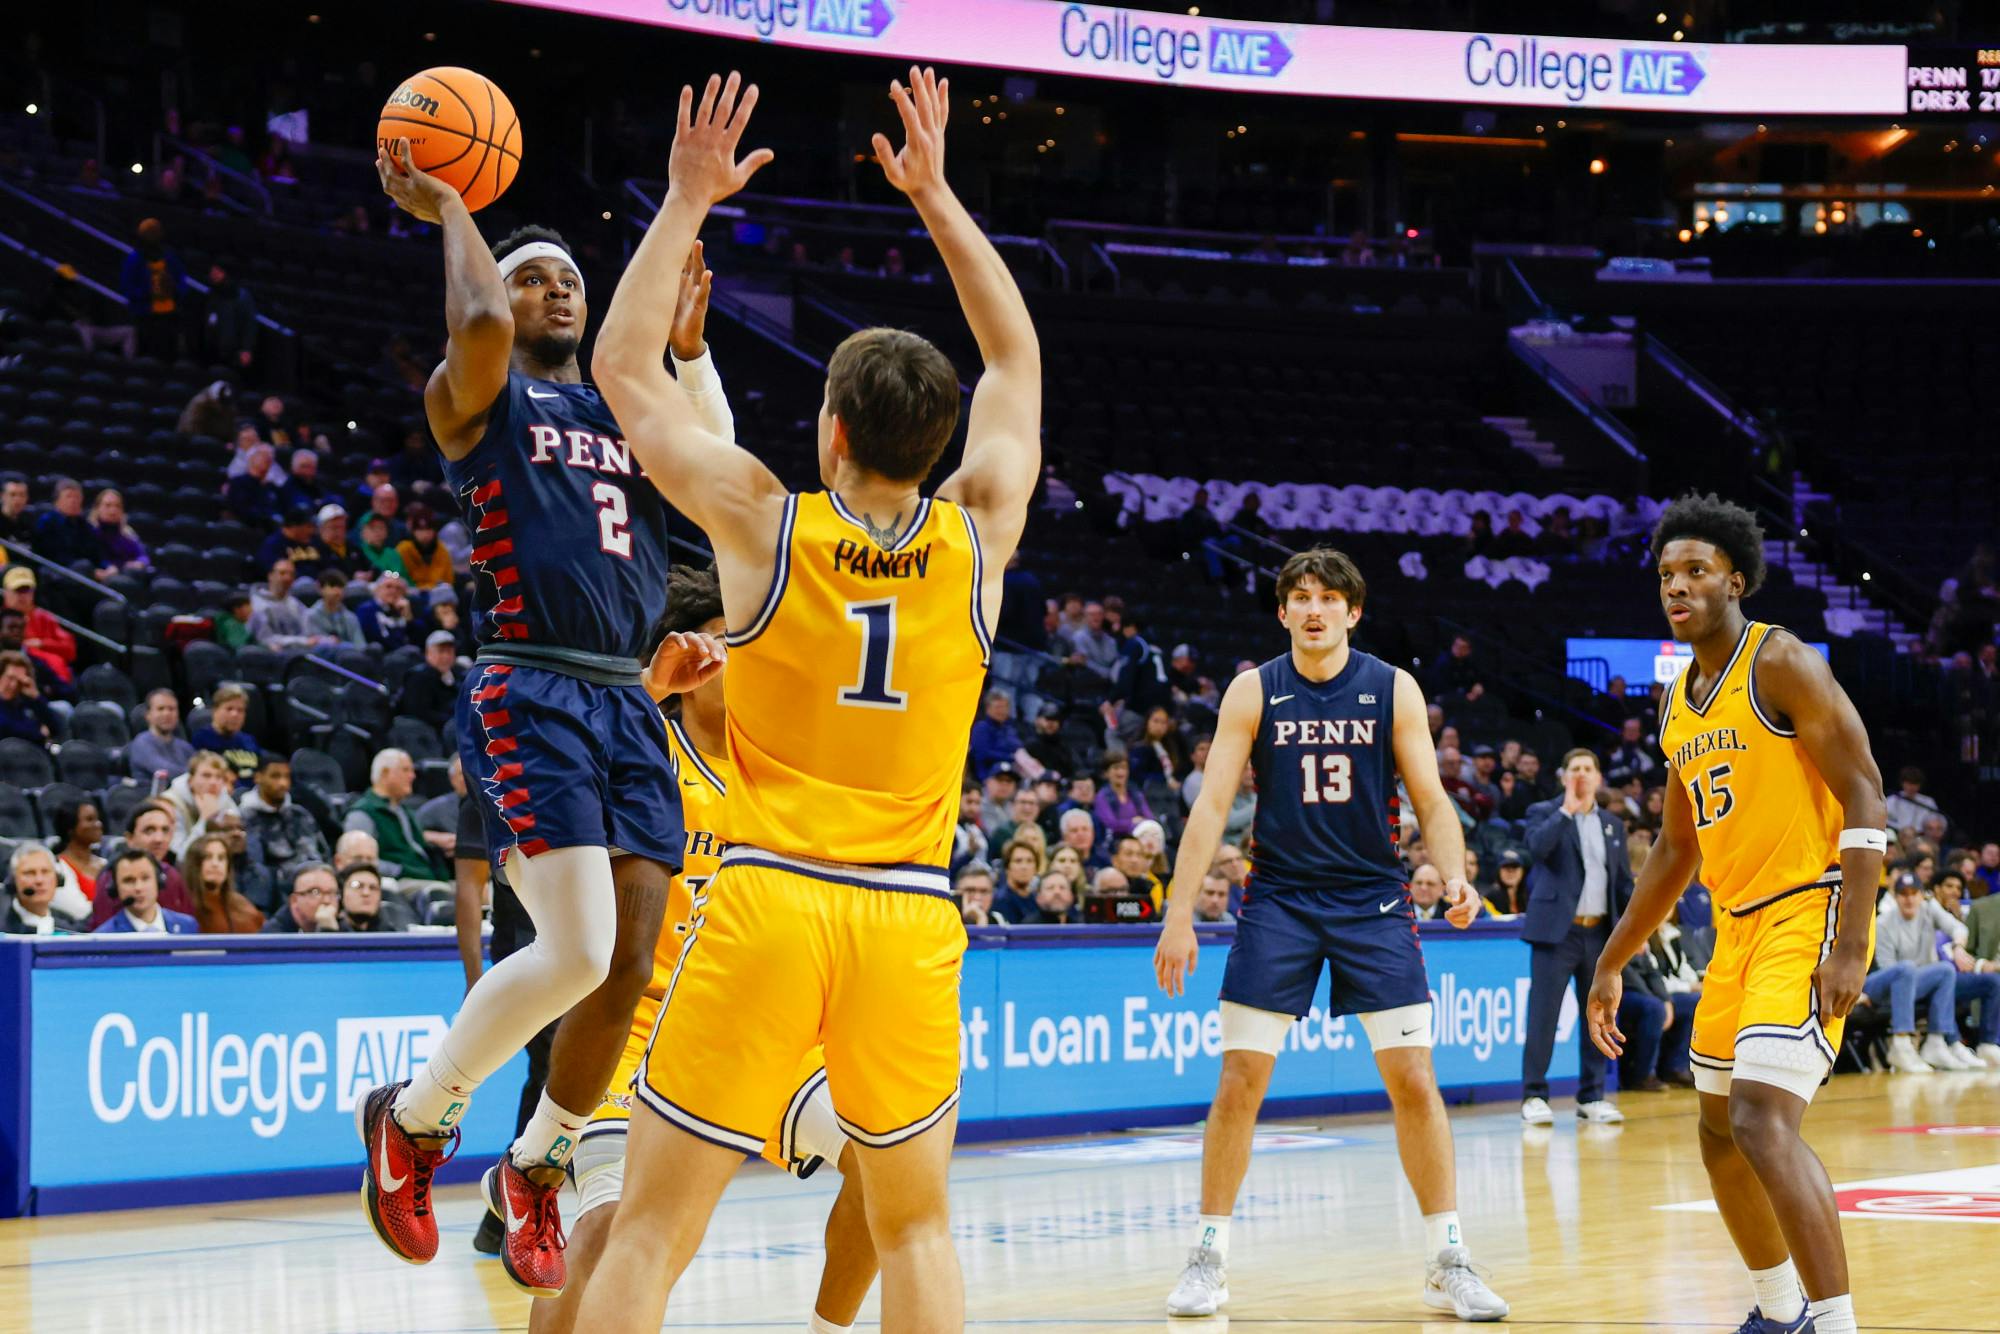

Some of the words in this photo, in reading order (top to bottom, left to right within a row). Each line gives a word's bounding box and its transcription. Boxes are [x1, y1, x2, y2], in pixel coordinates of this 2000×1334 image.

[1061, 6, 1201, 78] College
[1212, 32, 1272, 73] AVE
[1466, 35, 1612, 101] College
[1625, 53, 1686, 92] AVE
[389, 85, 440, 117] lson
[1908, 67, 1966, 87] PENN
[1911, 90, 1971, 111] DREX
[528, 424, 648, 478] PEN
[592, 480, 633, 561] 2
[834, 538, 931, 578] PANOV
[836, 595, 909, 712] 1
[1274, 719, 1376, 746] PENN
[1300, 753, 1352, 804] 13
[1690, 761, 1735, 830] 15
[1004, 1001, 1110, 1067] Loan
[88, 1011, 327, 1138] College
